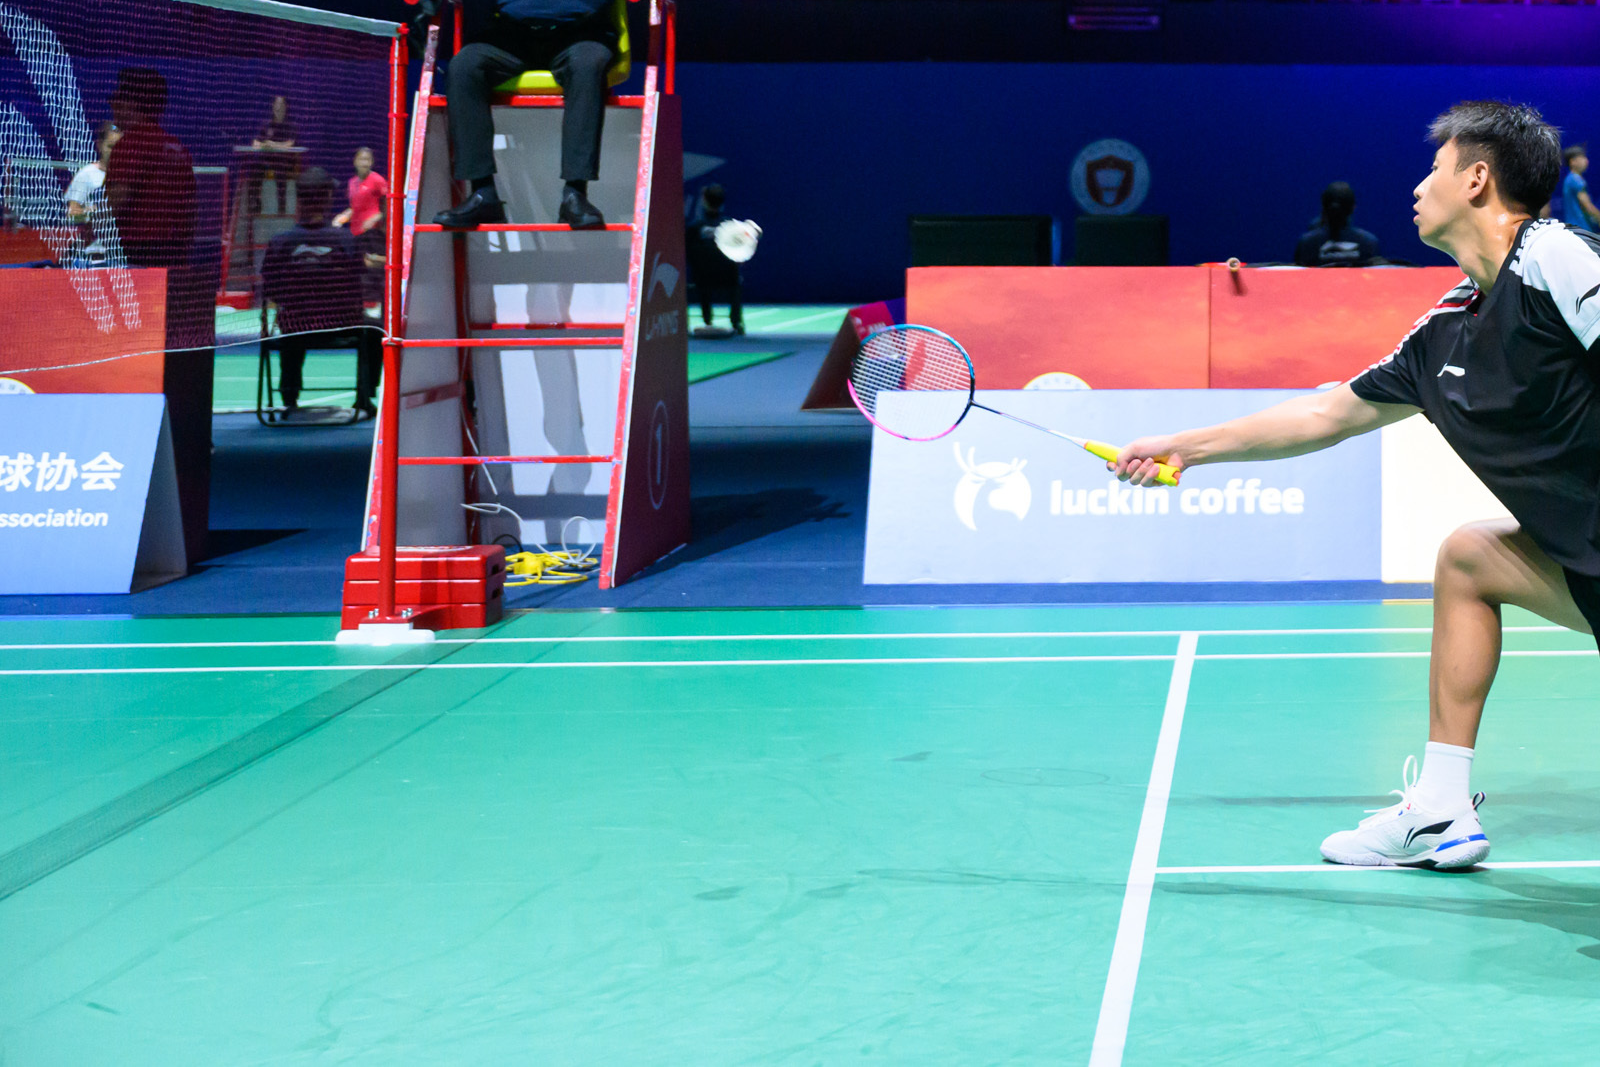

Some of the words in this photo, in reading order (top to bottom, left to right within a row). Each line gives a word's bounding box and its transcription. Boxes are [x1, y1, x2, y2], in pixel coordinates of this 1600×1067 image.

[0, 452, 125, 492] 球协会
[1050, 480, 1170, 515] luckin
[1180, 479, 1305, 514] coffee
